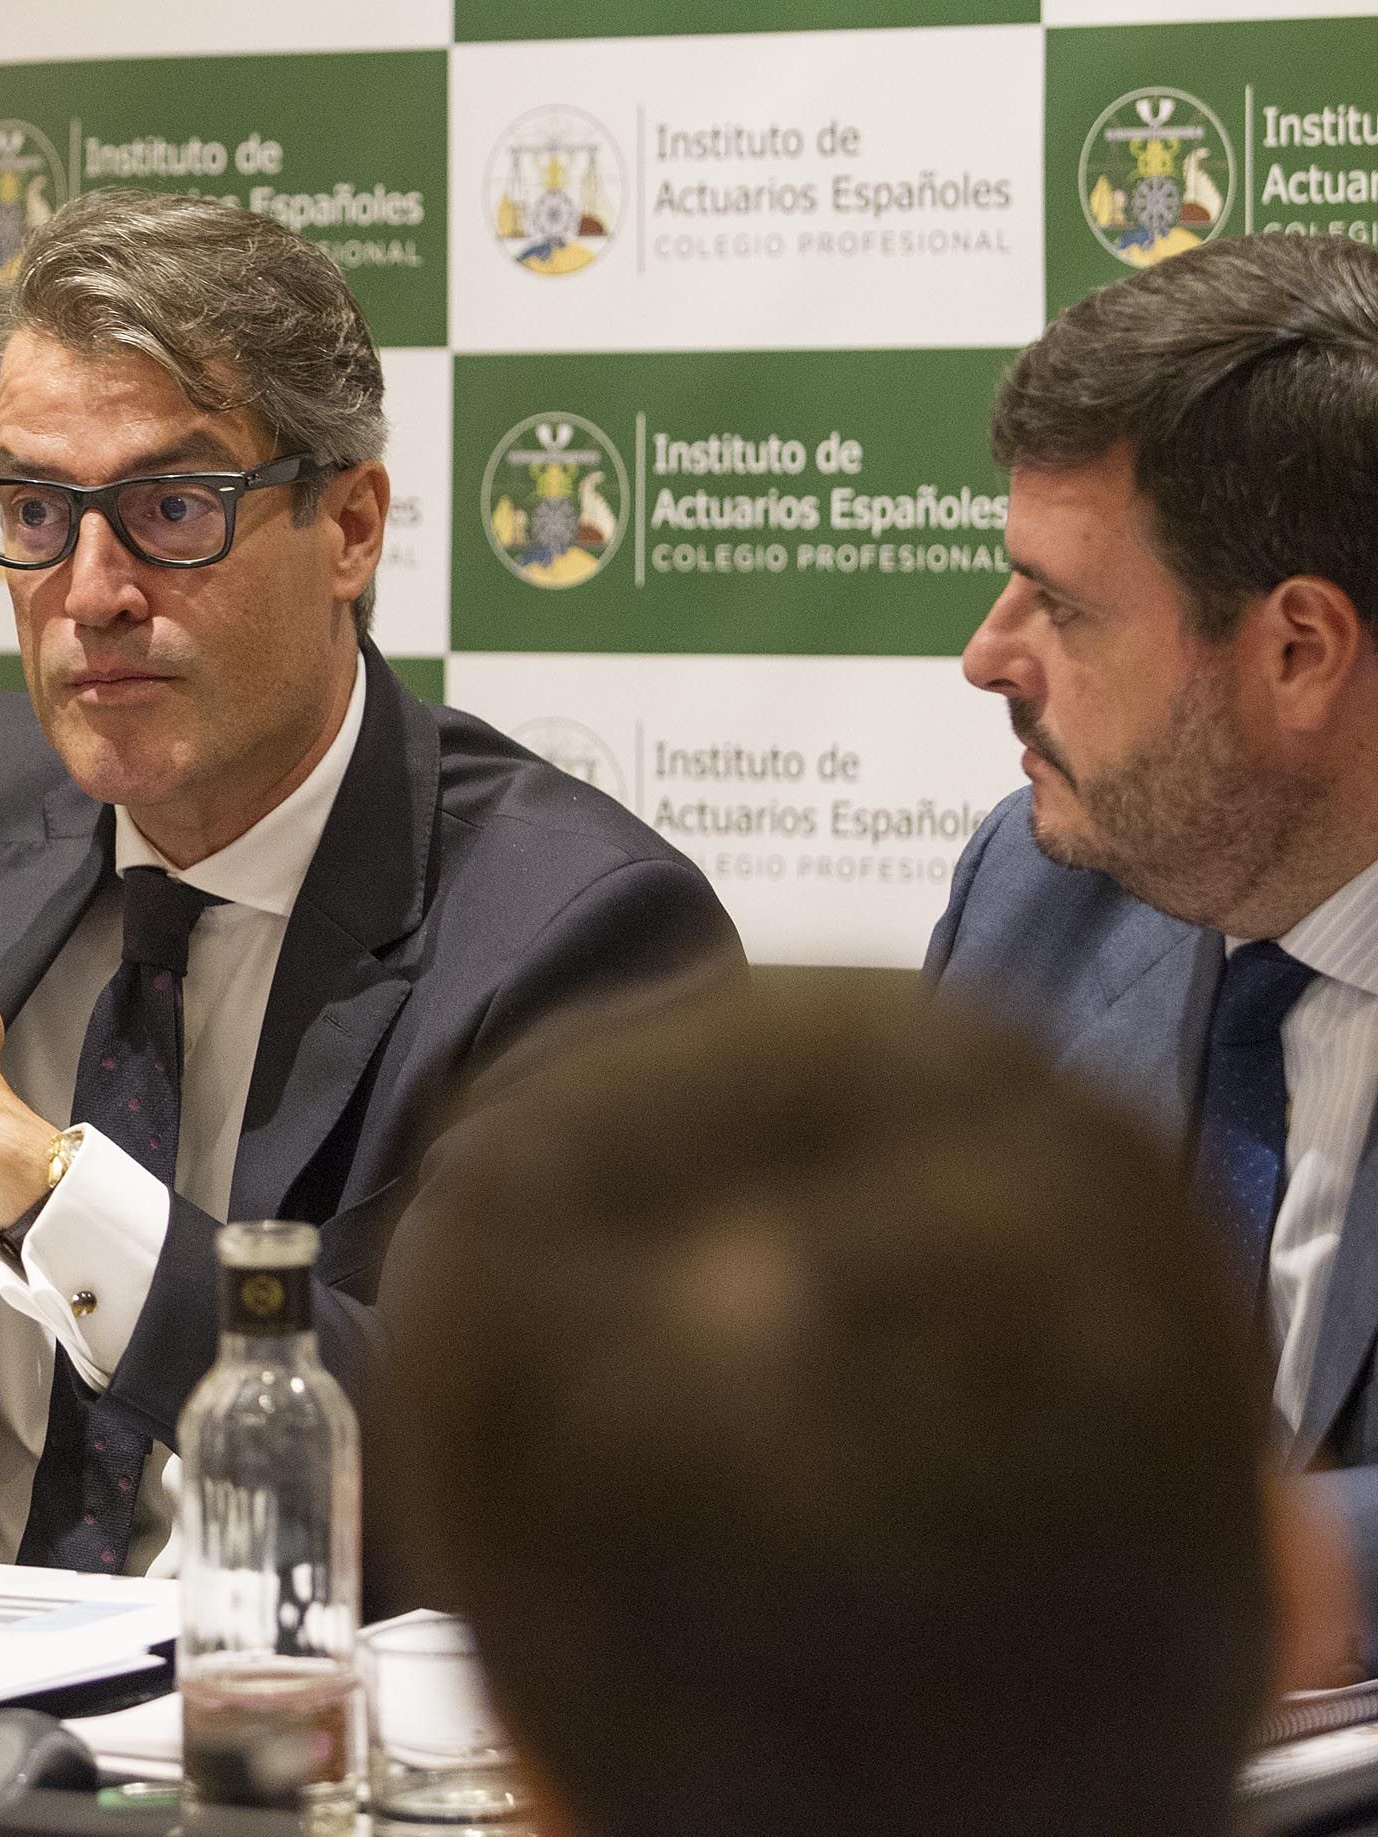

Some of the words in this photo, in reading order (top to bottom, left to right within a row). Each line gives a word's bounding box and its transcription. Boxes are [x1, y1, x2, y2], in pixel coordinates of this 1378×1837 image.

[86, 137, 227, 176] Instituto
[235, 133, 283, 175] de
[656, 123, 804, 160] Instituto
[816, 119, 861, 158] de
[654, 179, 818, 216] Actuarios
[831, 170, 1011, 220] Españoles
[654, 233, 785, 258] COLEGIO
[798, 229, 1012, 257] PROFESIONAL
[654, 433, 807, 475] Instituto
[816, 431, 863, 474] de
[652, 488, 820, 530] Actuarios
[830, 484, 1009, 538] Españoles
[652, 544, 788, 573] COLEGIO
[797, 543, 1010, 573] PROFESIONAL
[656, 741, 805, 782] Instituto
[818, 743, 861, 783] de
[654, 796, 817, 837] Actuarios
[797, 855, 956, 884] PROFESIO
